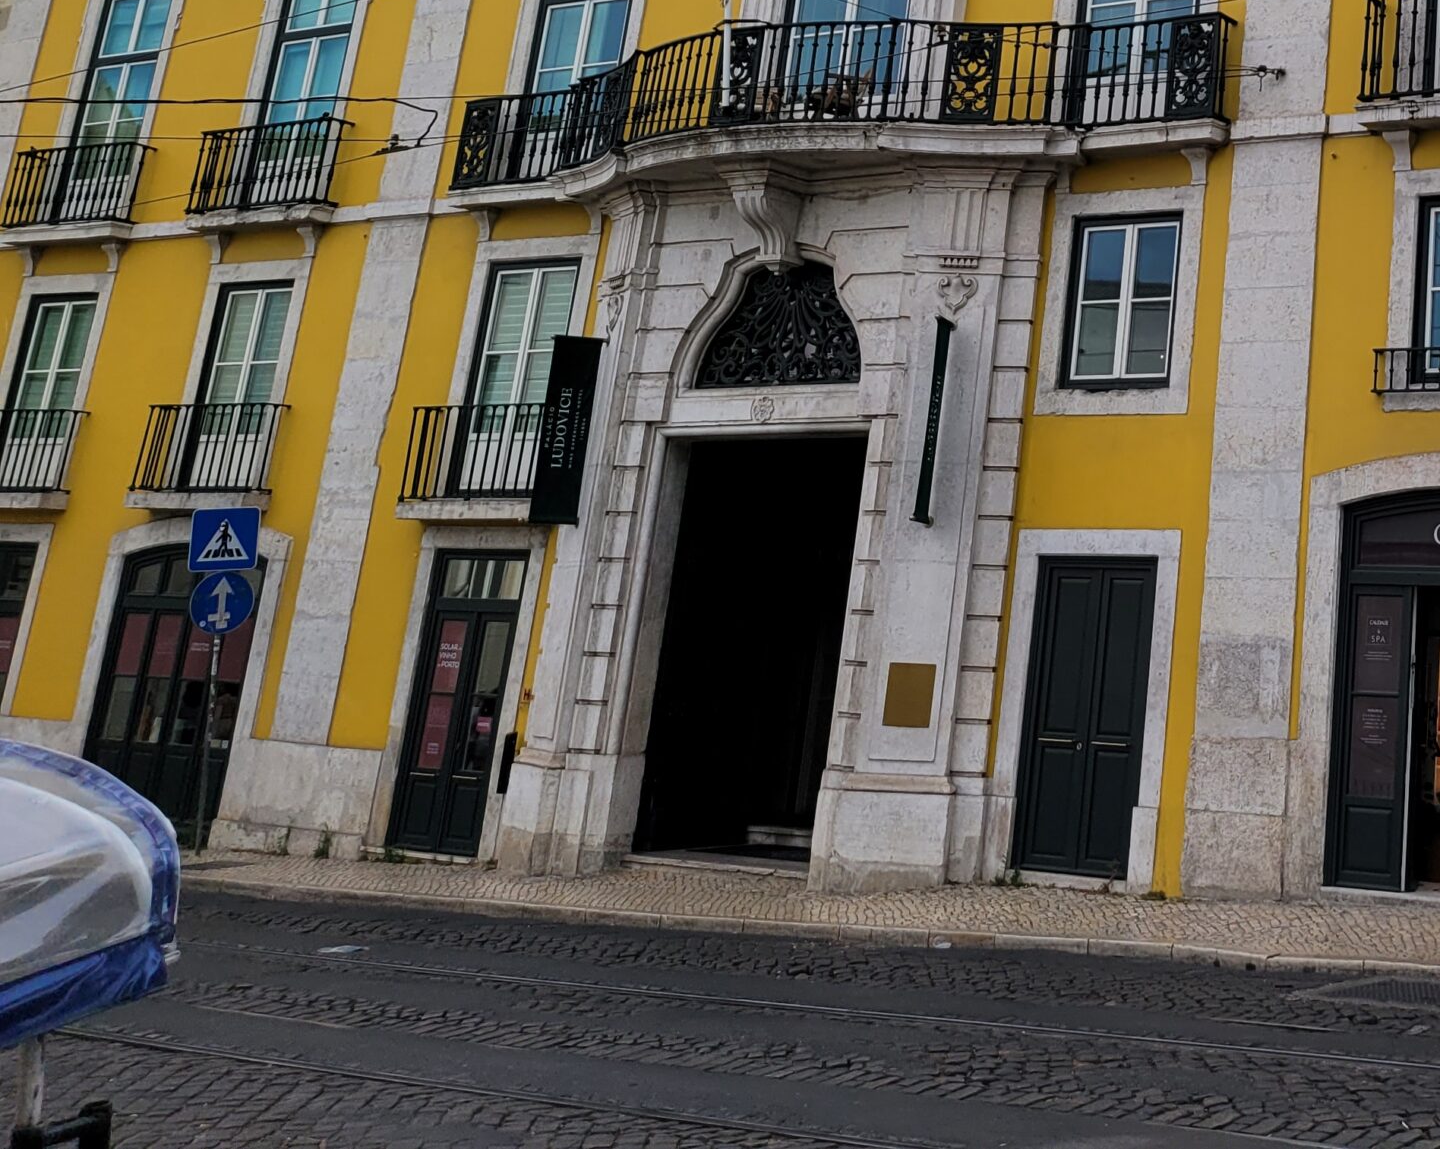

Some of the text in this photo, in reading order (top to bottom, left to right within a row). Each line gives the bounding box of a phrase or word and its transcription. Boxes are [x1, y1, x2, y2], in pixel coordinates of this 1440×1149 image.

[550, 387, 573, 468] LUDOVICE
[1371, 635, 1386, 643] SPA
[440, 642, 459, 650] SOLAR
[439, 651, 457, 659] VINHO
[441, 660, 460, 668] PORTO
